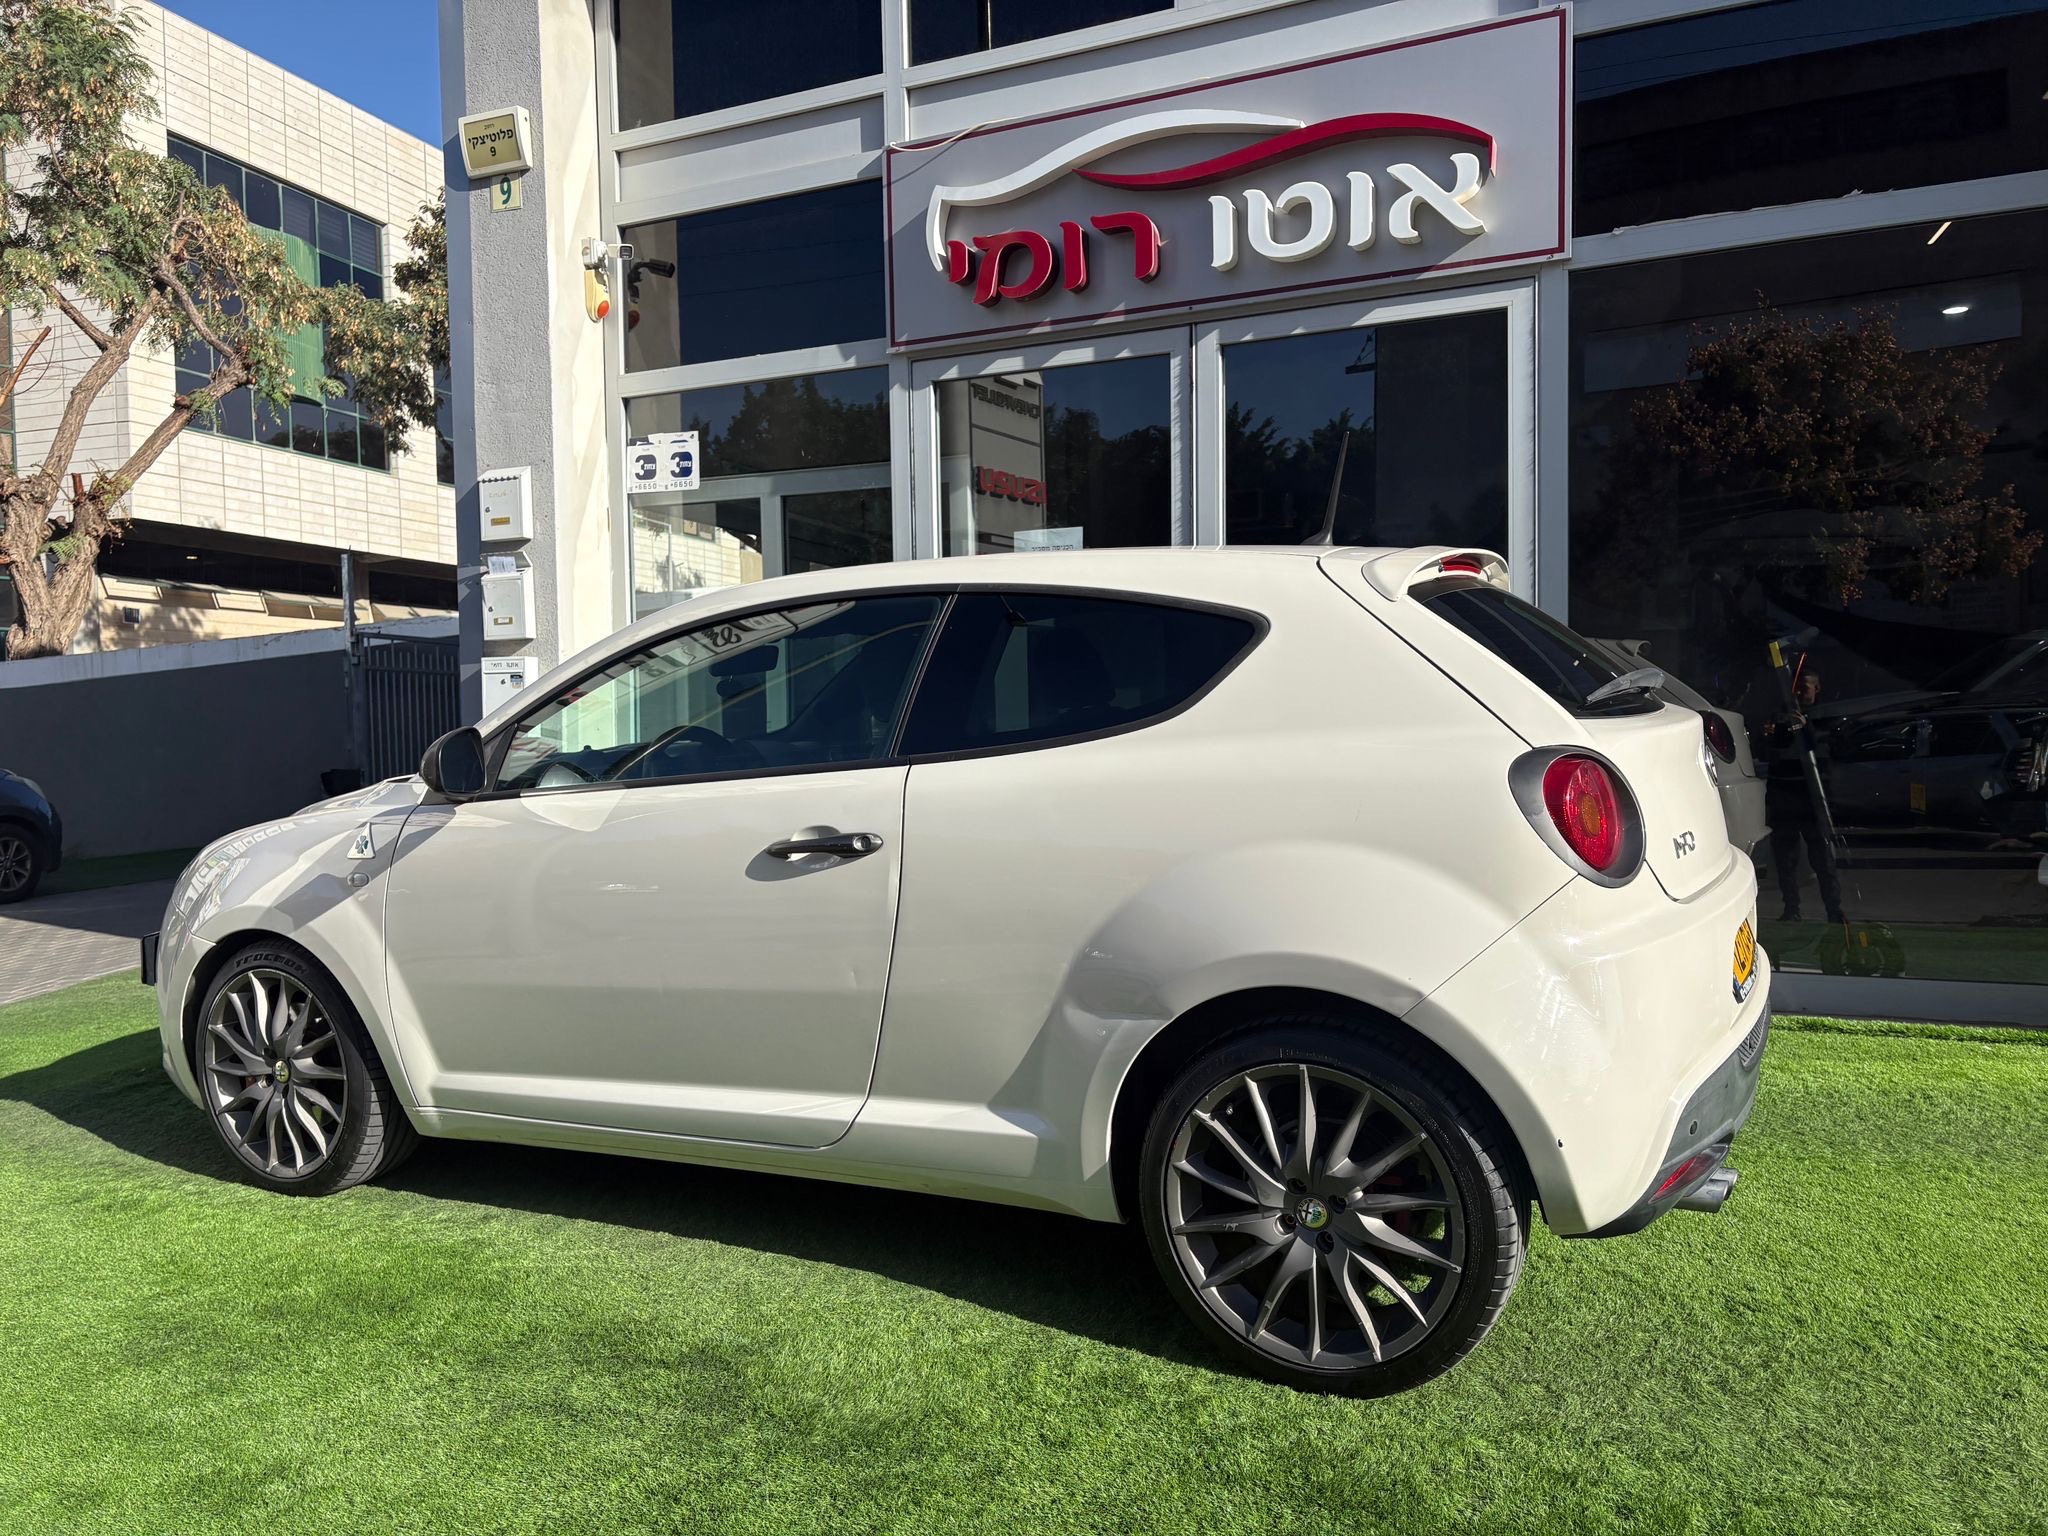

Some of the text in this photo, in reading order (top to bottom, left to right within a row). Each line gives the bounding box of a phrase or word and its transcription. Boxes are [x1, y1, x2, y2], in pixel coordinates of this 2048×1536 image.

[468, 128, 514, 150] פלוטיצקי
[490, 146, 497, 157] 9
[499, 175, 512, 205] 9
[948, 152, 1488, 307] אוטו רומי
